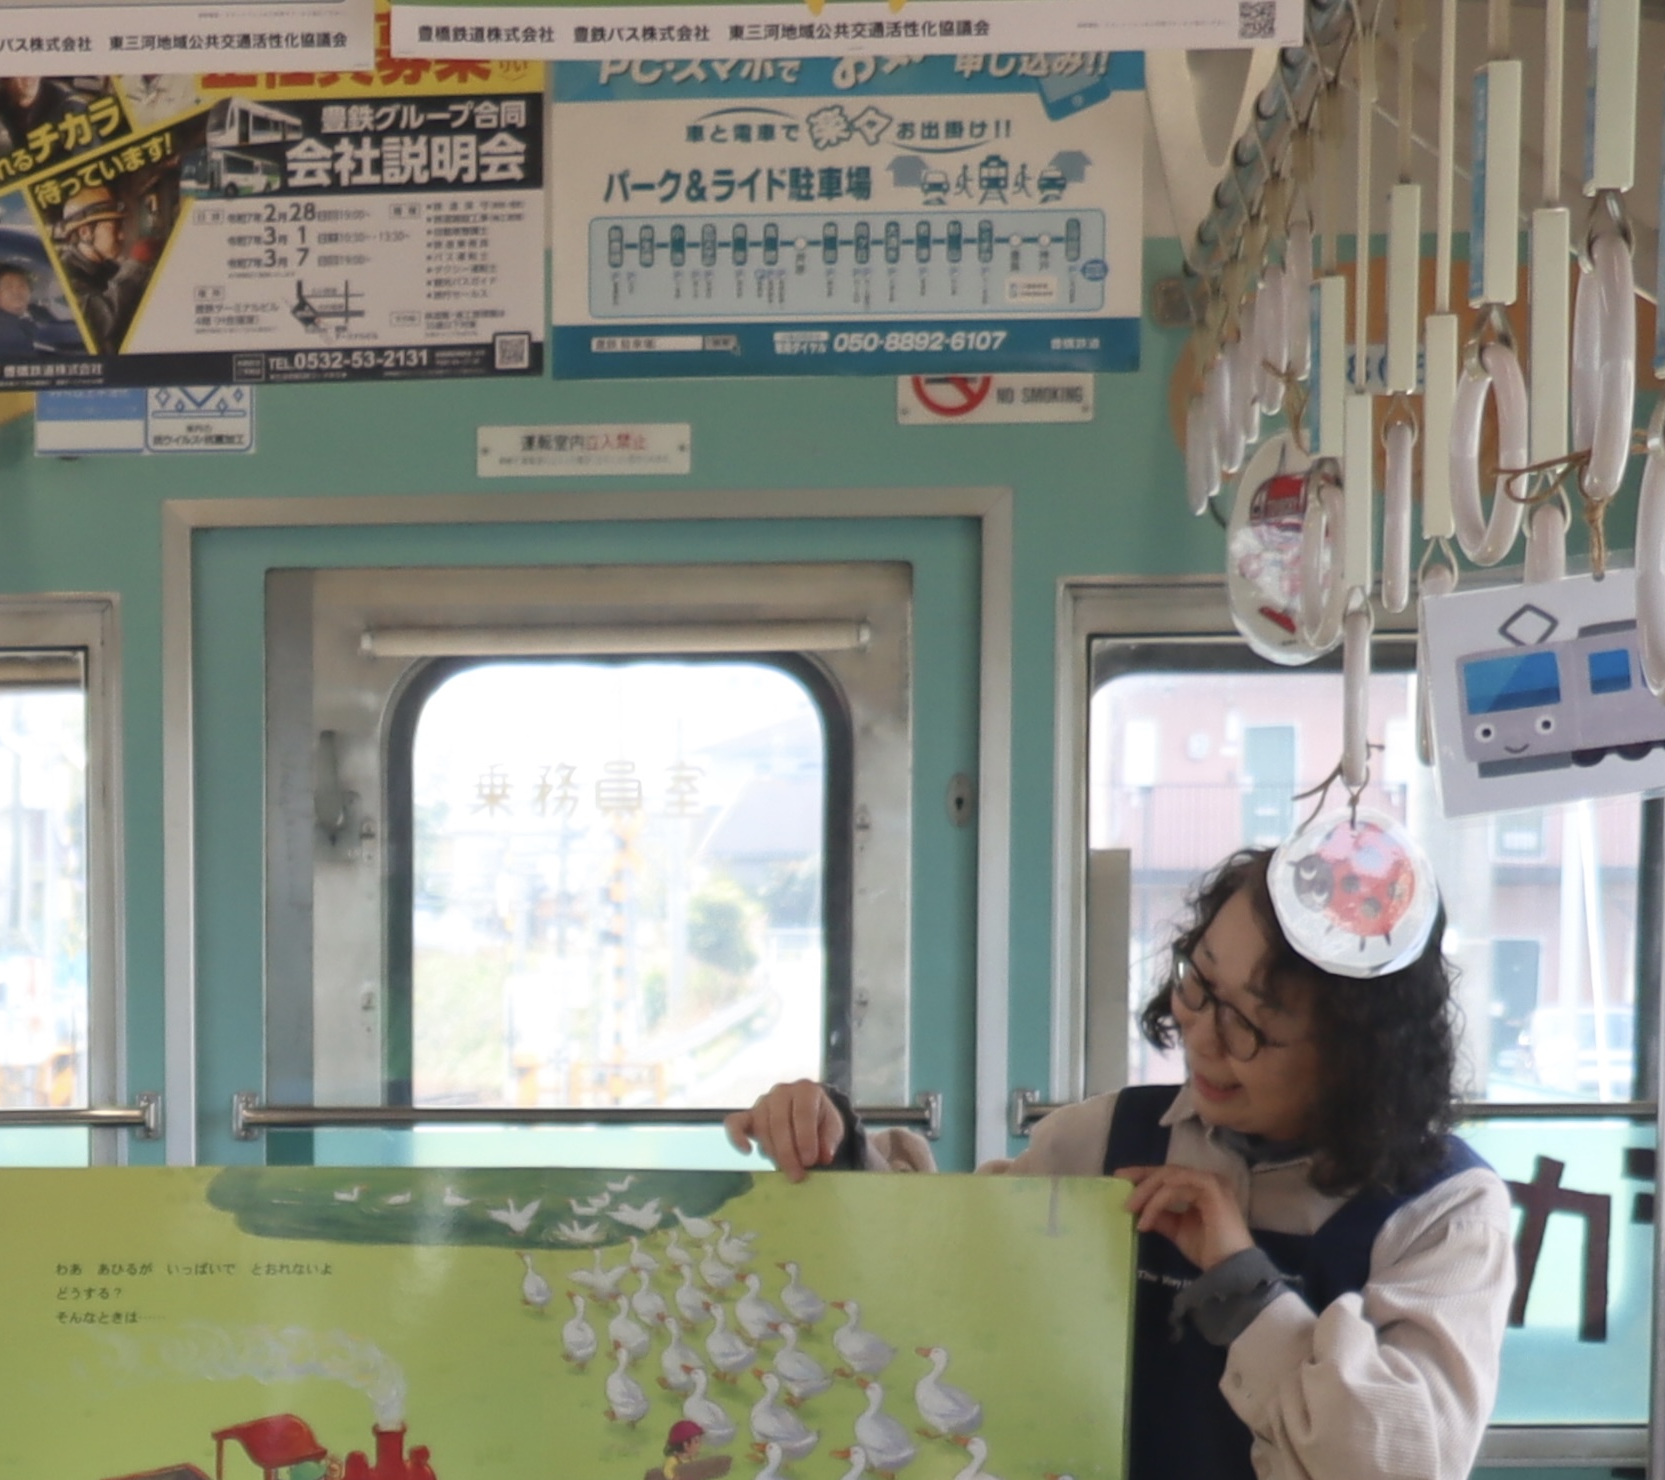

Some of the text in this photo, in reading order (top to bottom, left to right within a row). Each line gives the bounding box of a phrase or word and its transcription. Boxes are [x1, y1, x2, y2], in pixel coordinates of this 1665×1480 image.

[109, 31, 348, 51] 東三河地域公共交通活性化協議会
[418, 19, 991, 44] 豊橋鉄道株式会社 豊鉄バス株式会社 東三河地域公共交通活性化協議会
[320, 100, 528, 134] 豊鉄グループ合同
[34, 132, 174, 210] 待っています!
[285, 132, 527, 188] 会社説明会
[603, 165, 873, 204] パーク&ライド駐車場
[832, 330, 1008, 354] 050-8892-6107
[996, 385, 1084, 404] NO SMOKING
[470, 759, 708, 818] 乗務員室
[55, 1263, 333, 1277] わあ あひるが いっぱいで とおれないよ
[56, 1287, 122, 1300] どうする?
